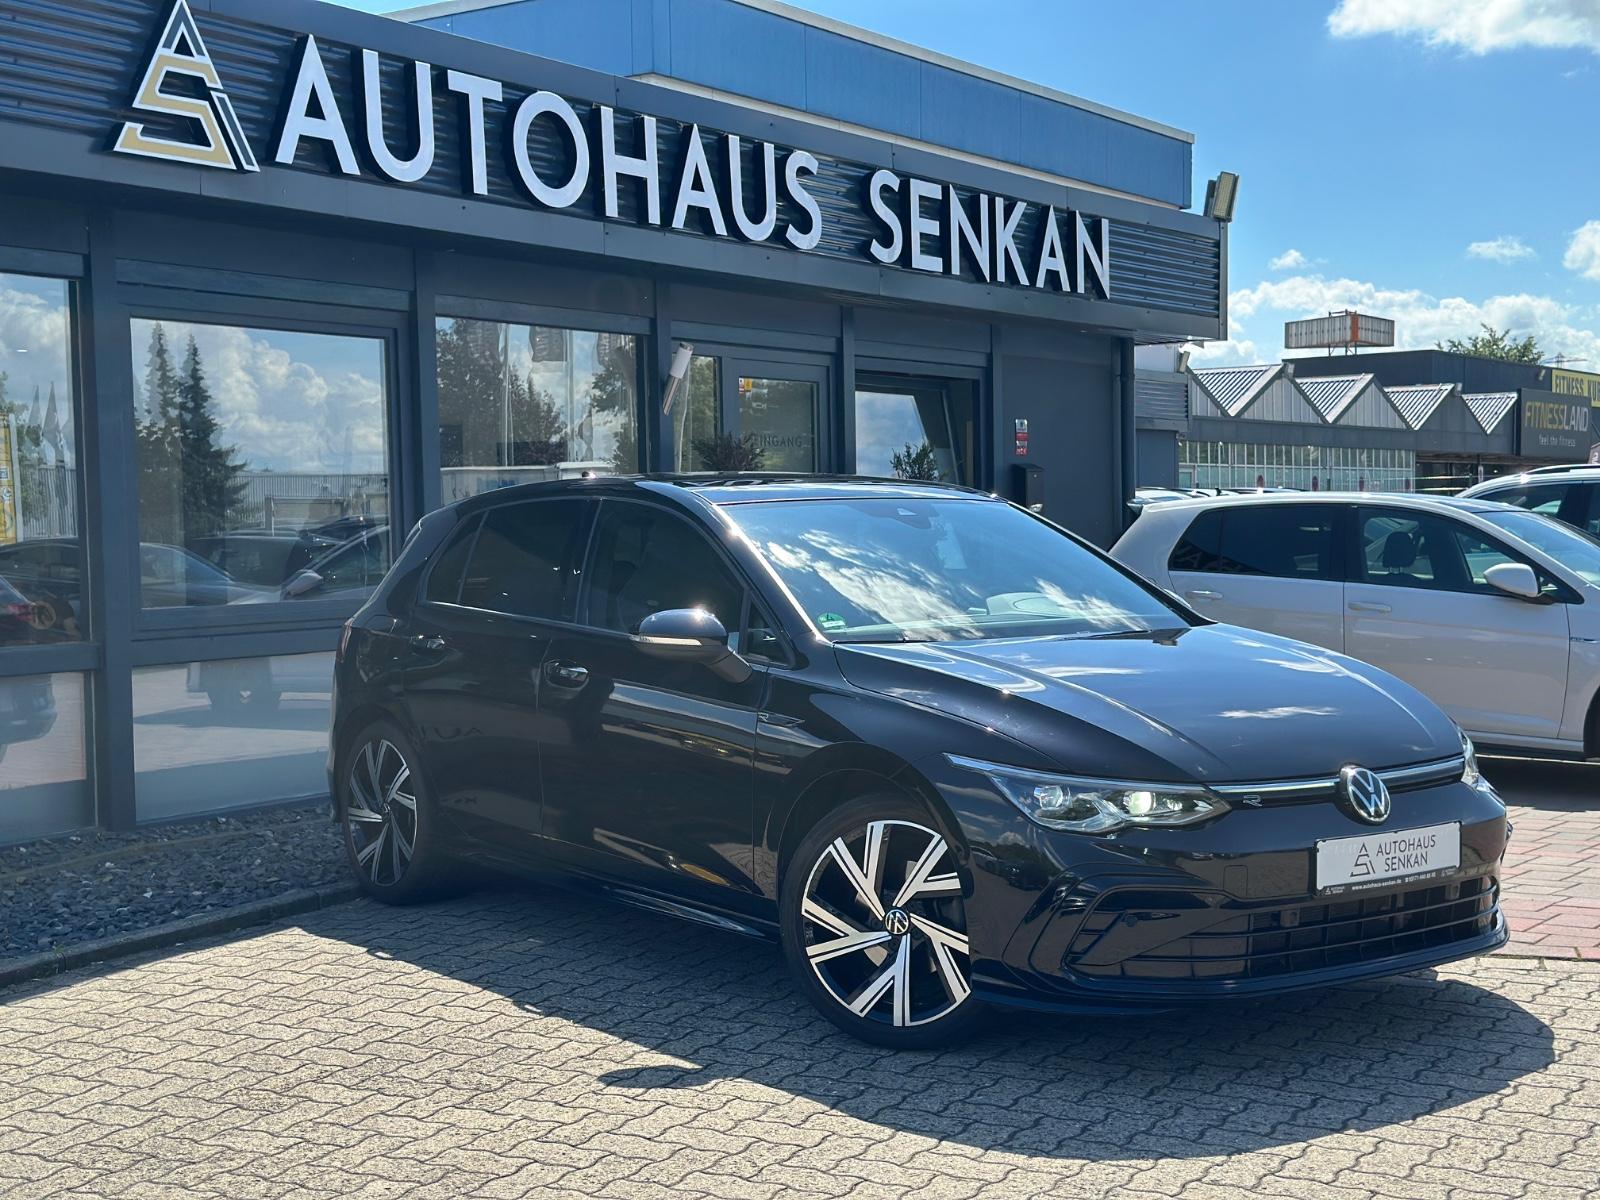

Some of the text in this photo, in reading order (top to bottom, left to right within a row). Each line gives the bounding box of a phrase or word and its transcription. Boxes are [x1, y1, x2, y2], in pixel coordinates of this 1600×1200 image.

[274, 34, 1111, 300] AUTOHAUS SENKAN
[1555, 374, 1584, 397] FITNESS
[1525, 401, 1588, 432] FITNESSLAND
[1376, 834, 1436, 857] AUTOHAUS
[1384, 851, 1428, 873] SENKAN
